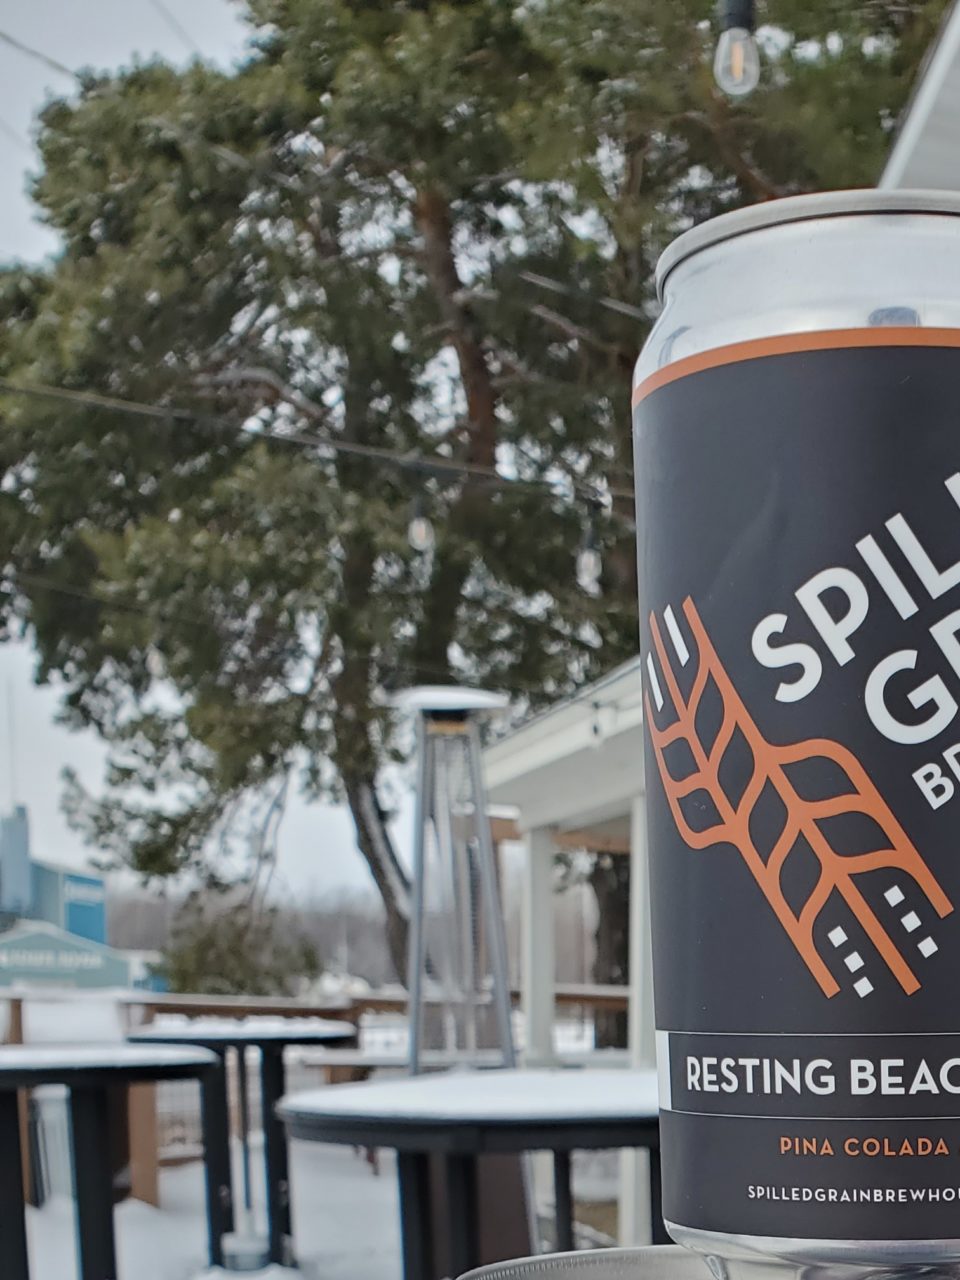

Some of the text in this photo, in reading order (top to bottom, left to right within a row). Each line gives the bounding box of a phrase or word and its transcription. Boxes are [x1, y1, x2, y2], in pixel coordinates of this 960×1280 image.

[686, 1055, 836, 1096] RESTING
[780, 1136, 834, 1156] PINA
[844, 1137, 949, 1156] COLADA
